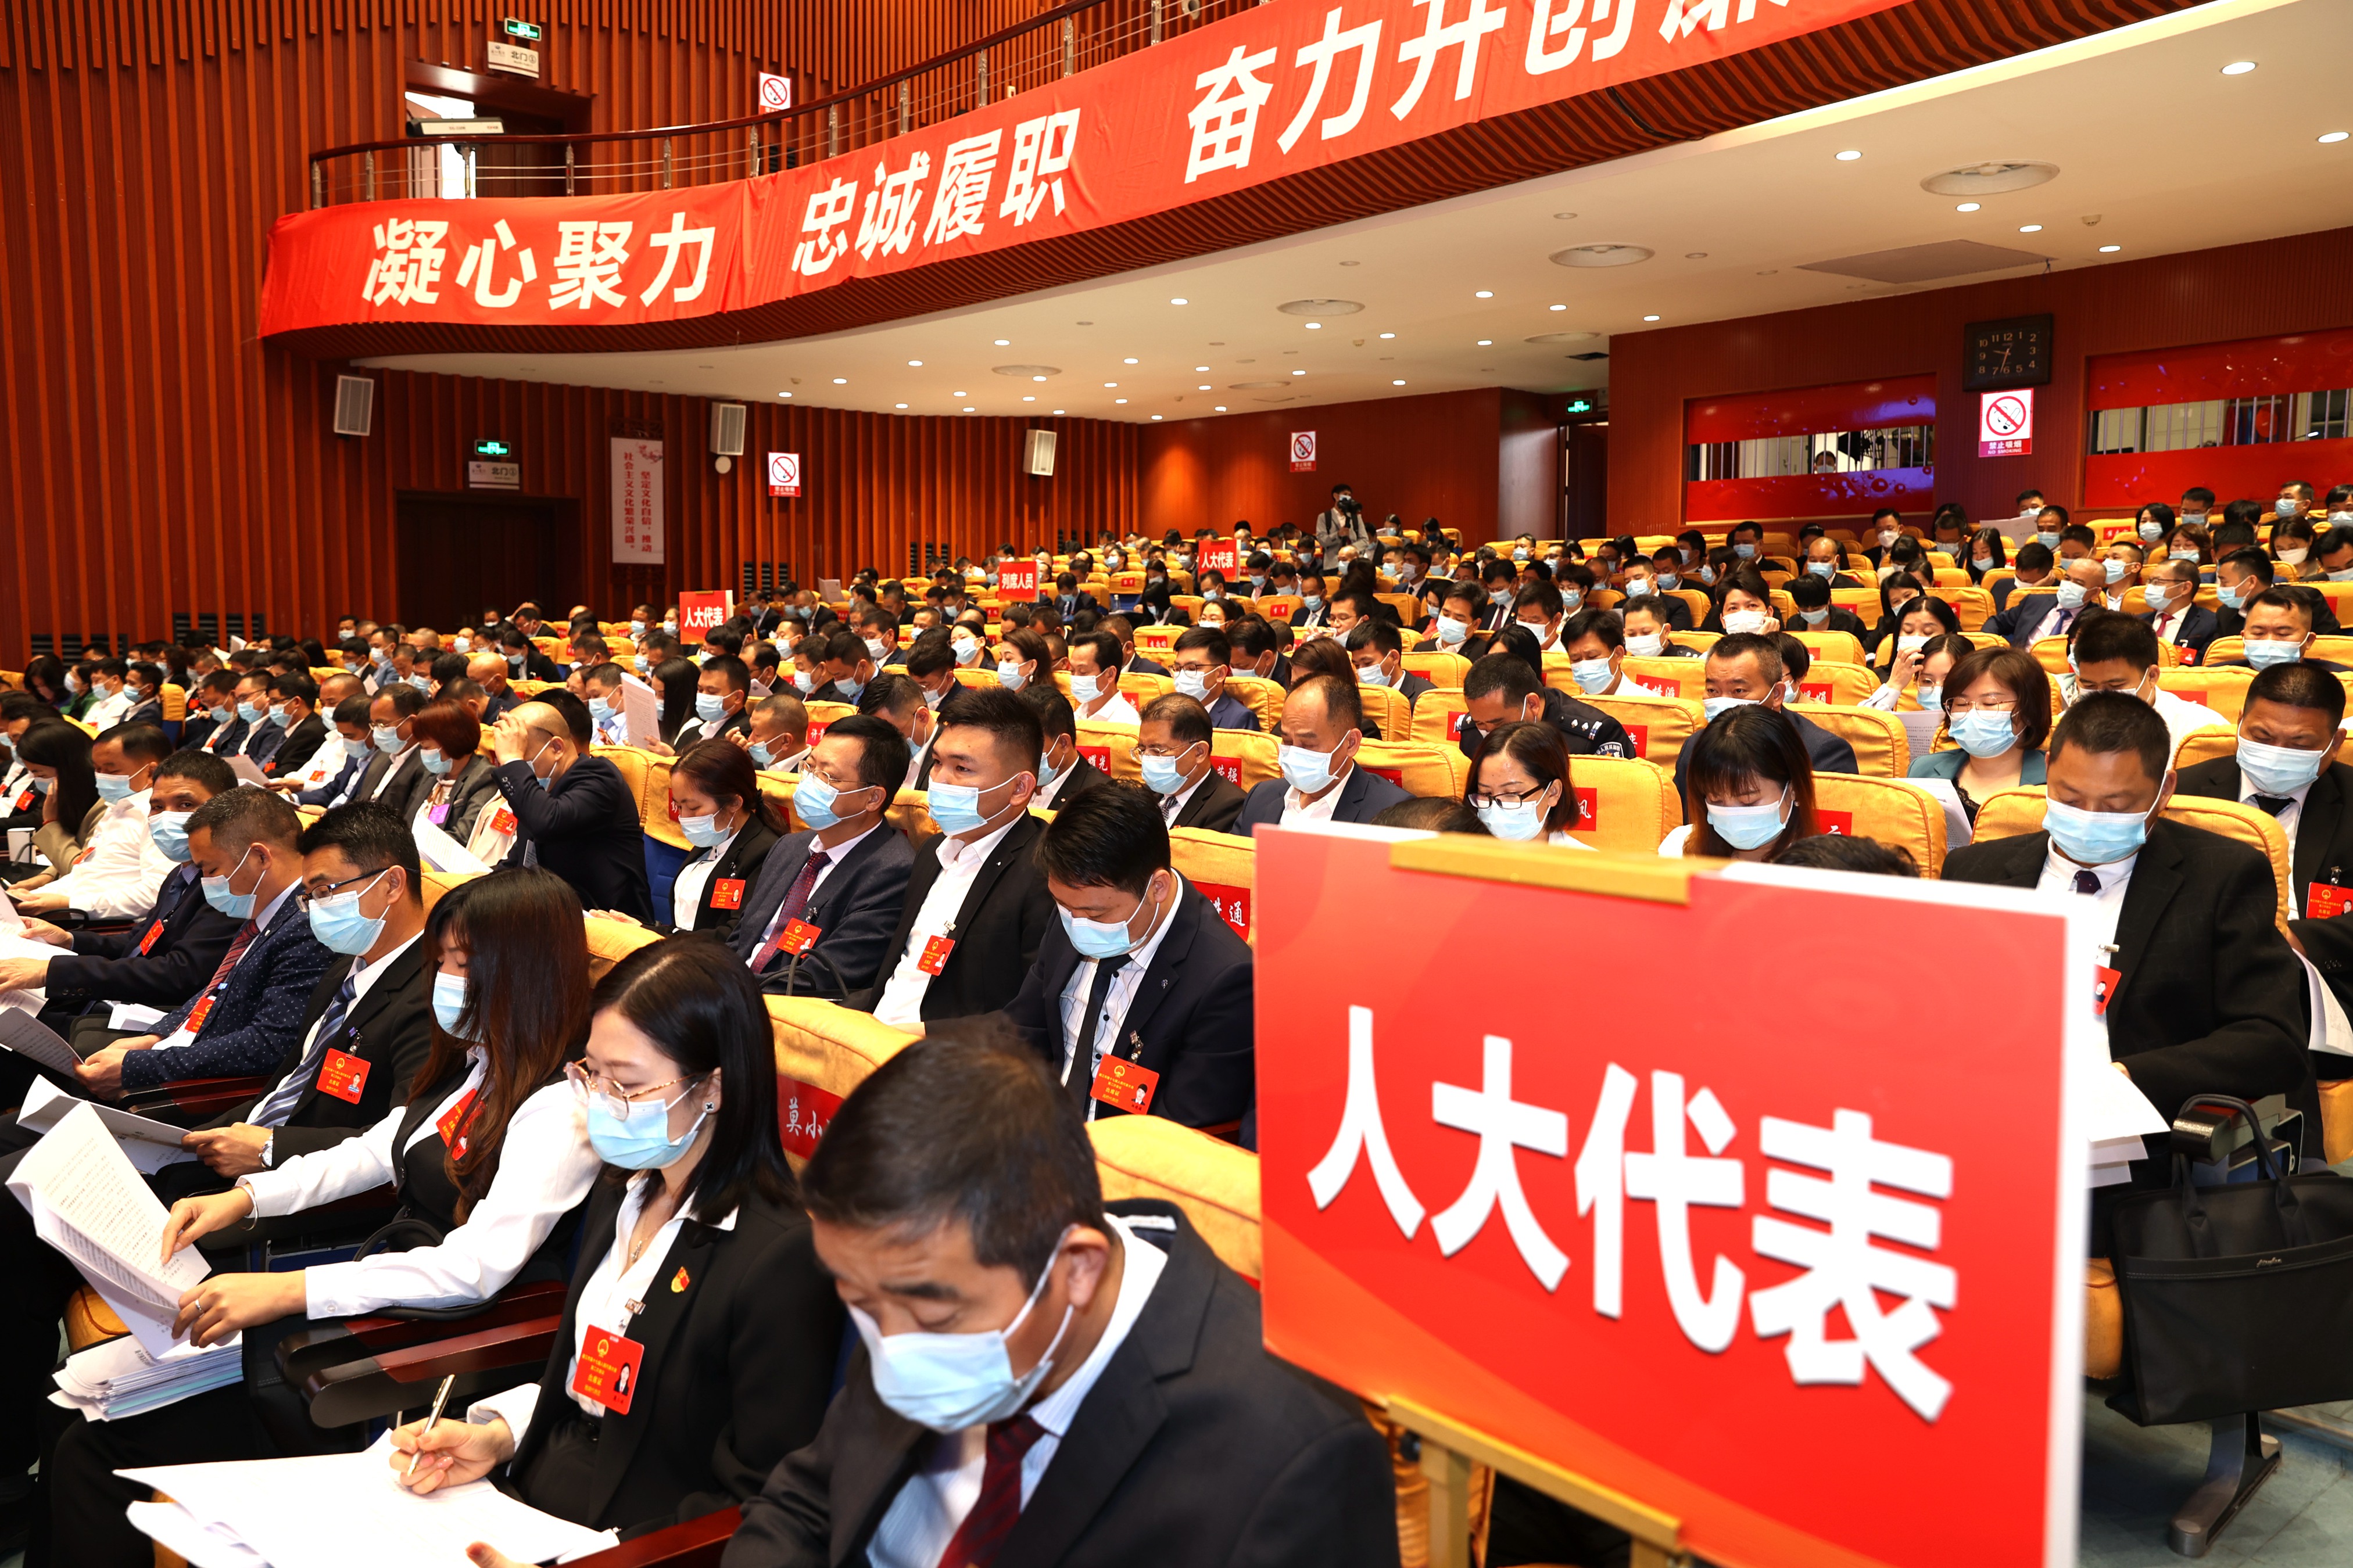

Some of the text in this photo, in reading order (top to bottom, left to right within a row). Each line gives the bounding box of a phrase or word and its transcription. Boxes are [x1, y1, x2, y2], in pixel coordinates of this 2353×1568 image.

[363, 212, 715, 310] 凝心聚力
[792, 108, 1080, 275] 忠诚履职
[2004, 332, 2013, 341] 12
[2030, 333, 2036, 342] 2
[1979, 352, 1986, 360] 9
[1979, 360, 2035, 375] 8 7 6 5 4
[1989, 440, 2022, 450] 禁止吸烟
[1201, 551, 1234, 568] 人大代表
[1001, 573, 1033, 589] 列席人员
[684, 606, 724, 628] 人大代表
[786, 1097, 831, 1139] 莫小
[1308, 1006, 1956, 1422] 人大代表
